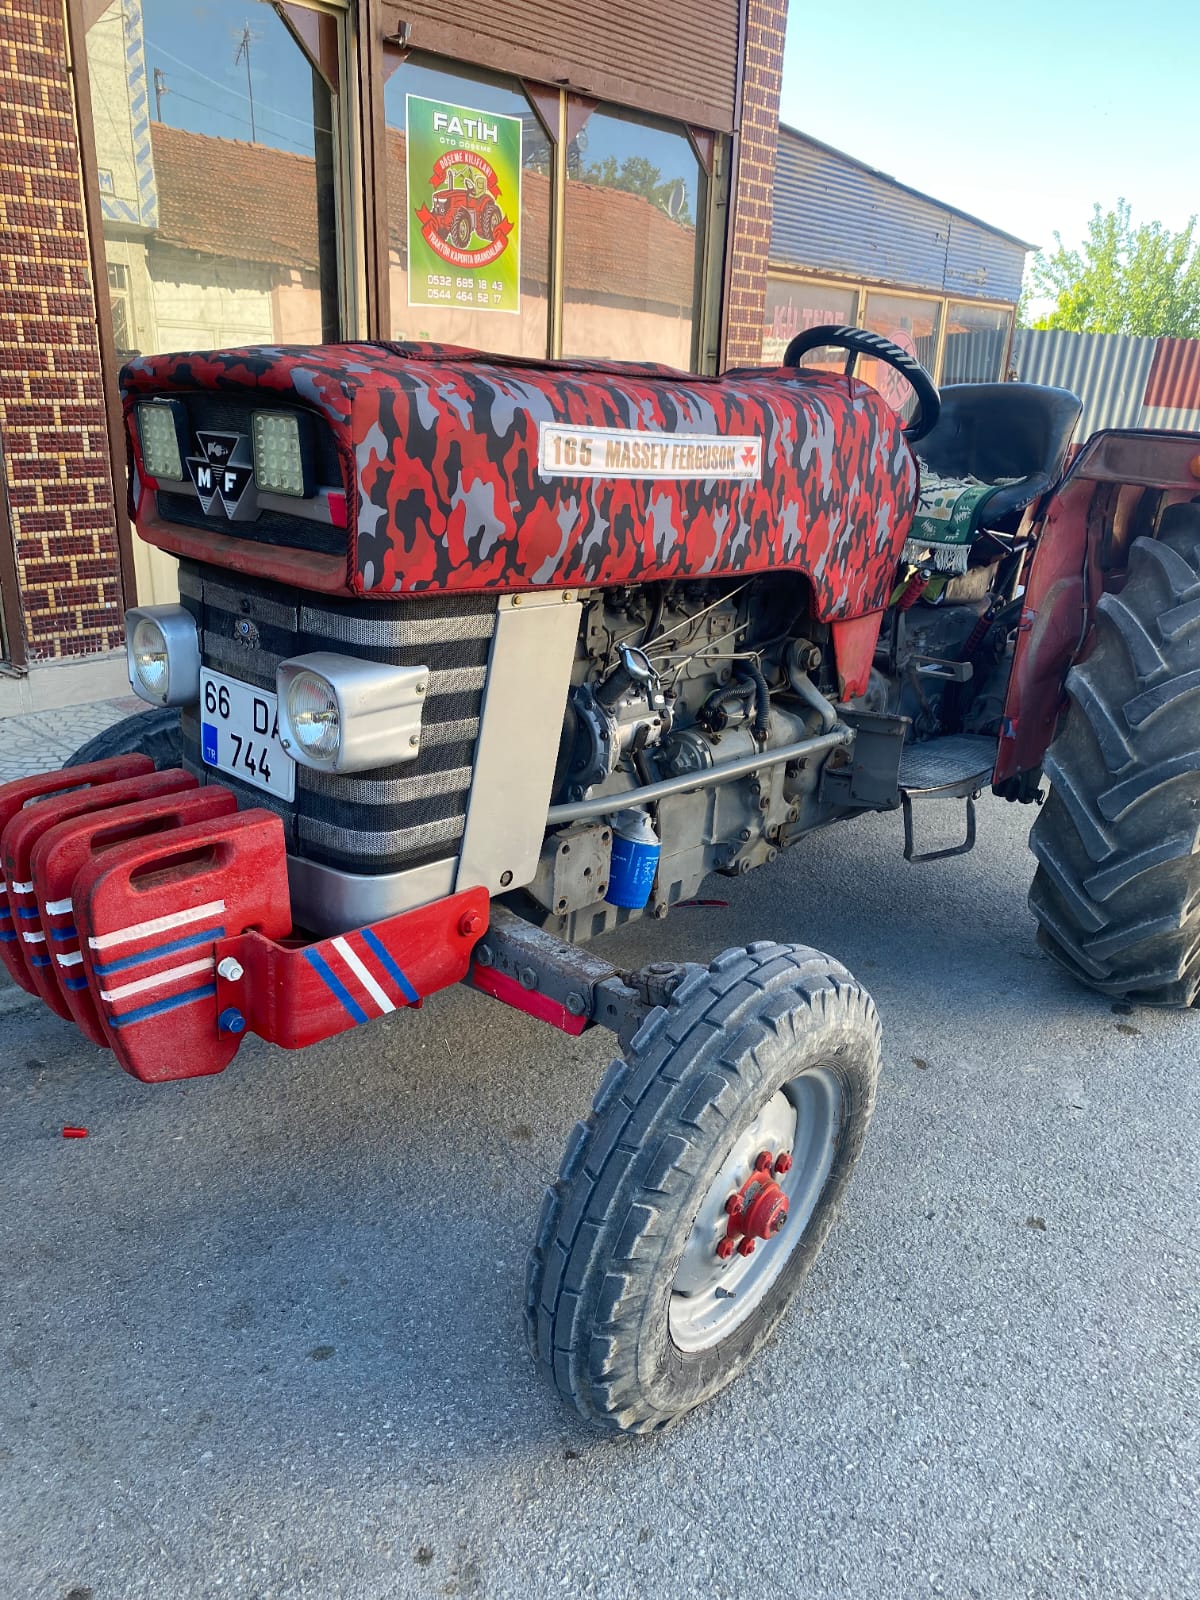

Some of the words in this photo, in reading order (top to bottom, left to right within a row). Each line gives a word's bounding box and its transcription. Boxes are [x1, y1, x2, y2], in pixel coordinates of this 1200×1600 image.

[433, 111, 499, 144] FATİH
[439, 136, 457, 146] OTO
[427, 274, 452, 287] 0532
[478, 279, 487, 290] 18
[491, 281, 503, 291] 43
[427, 288, 451, 300] 0544
[553, 435, 593, 467] 165
[605, 440, 669, 470] MASSEY
[671, 444, 736, 471] FERGUSON
[205, 680, 230, 719] 66
[206, 746, 216, 760] TR
[231, 732, 271, 783] 744
